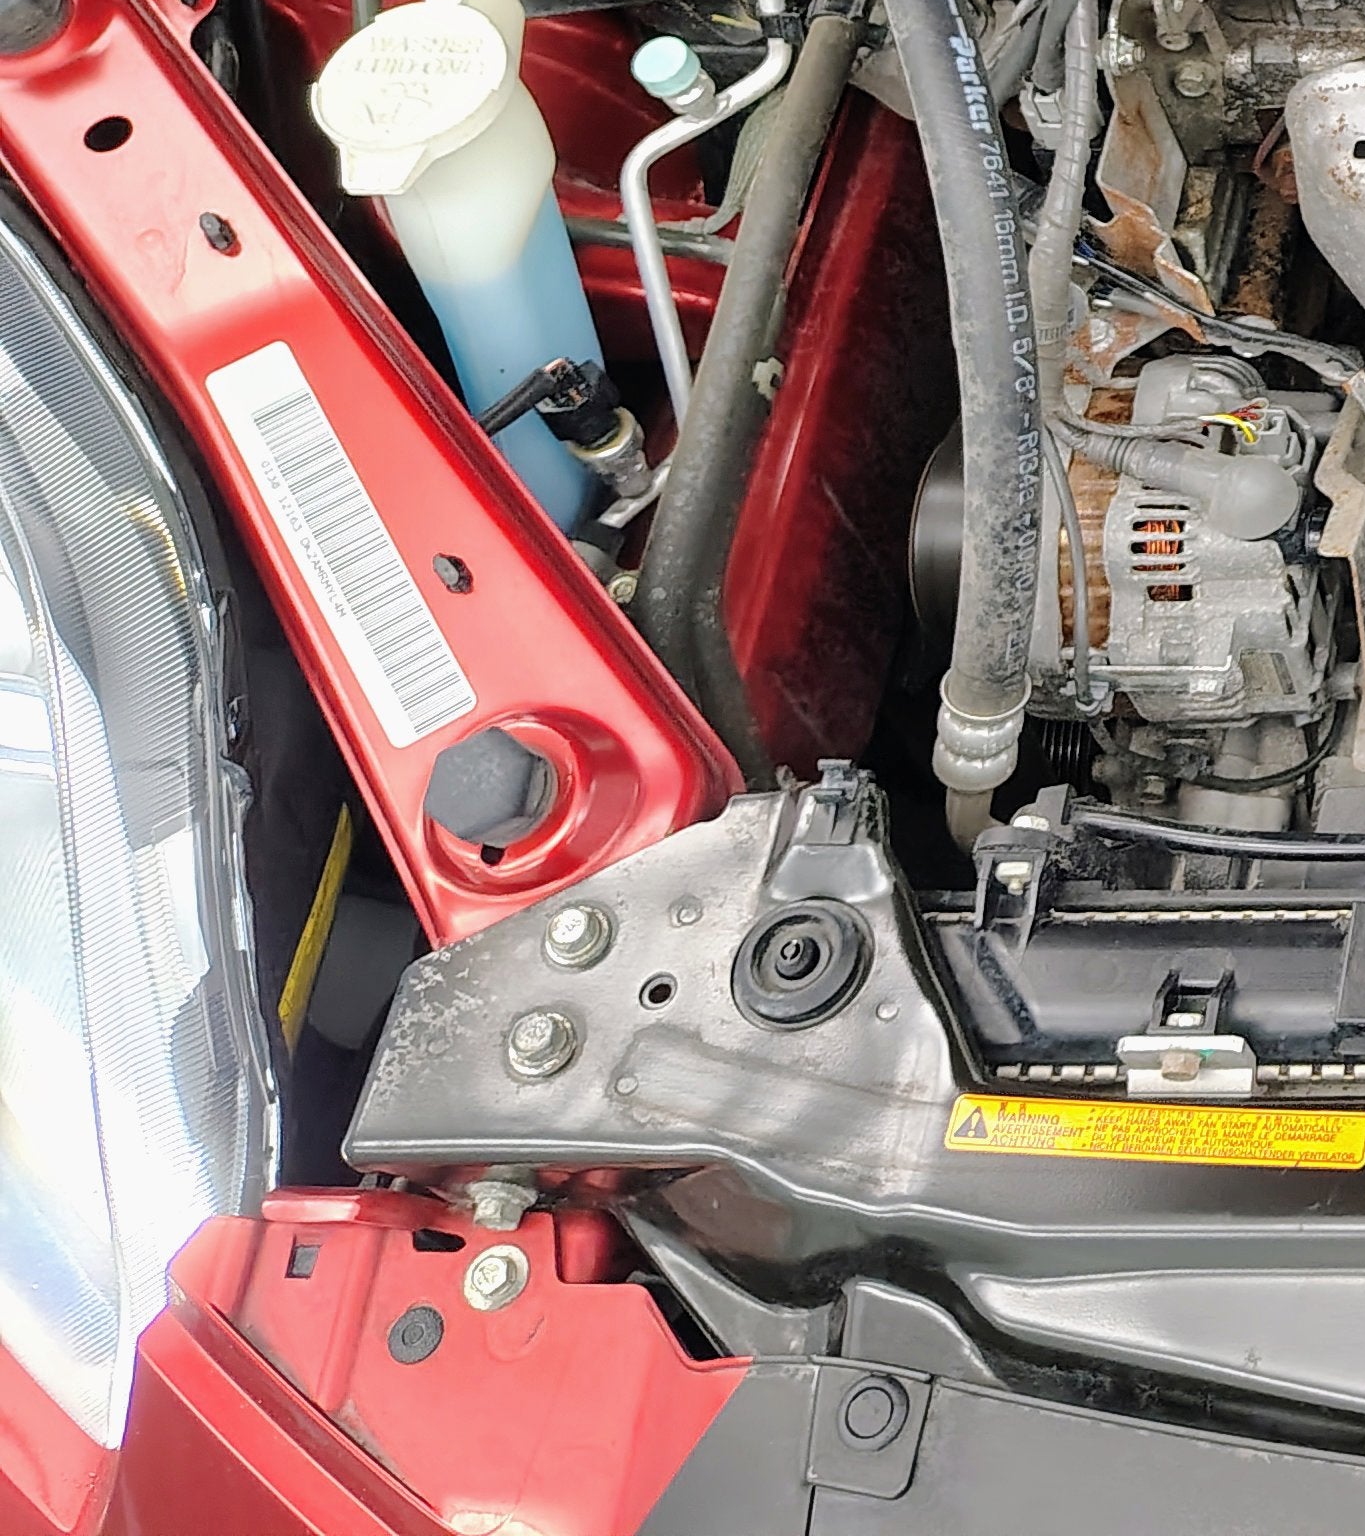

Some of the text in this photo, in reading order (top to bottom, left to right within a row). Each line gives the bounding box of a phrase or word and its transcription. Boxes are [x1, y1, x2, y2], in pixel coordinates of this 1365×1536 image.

[949, 36, 993, 133] Parker
[978, 140, 1011, 201] 7641
[991, 208, 1023, 285] 16mm
[998, 1111, 1060, 1124] WARNING
